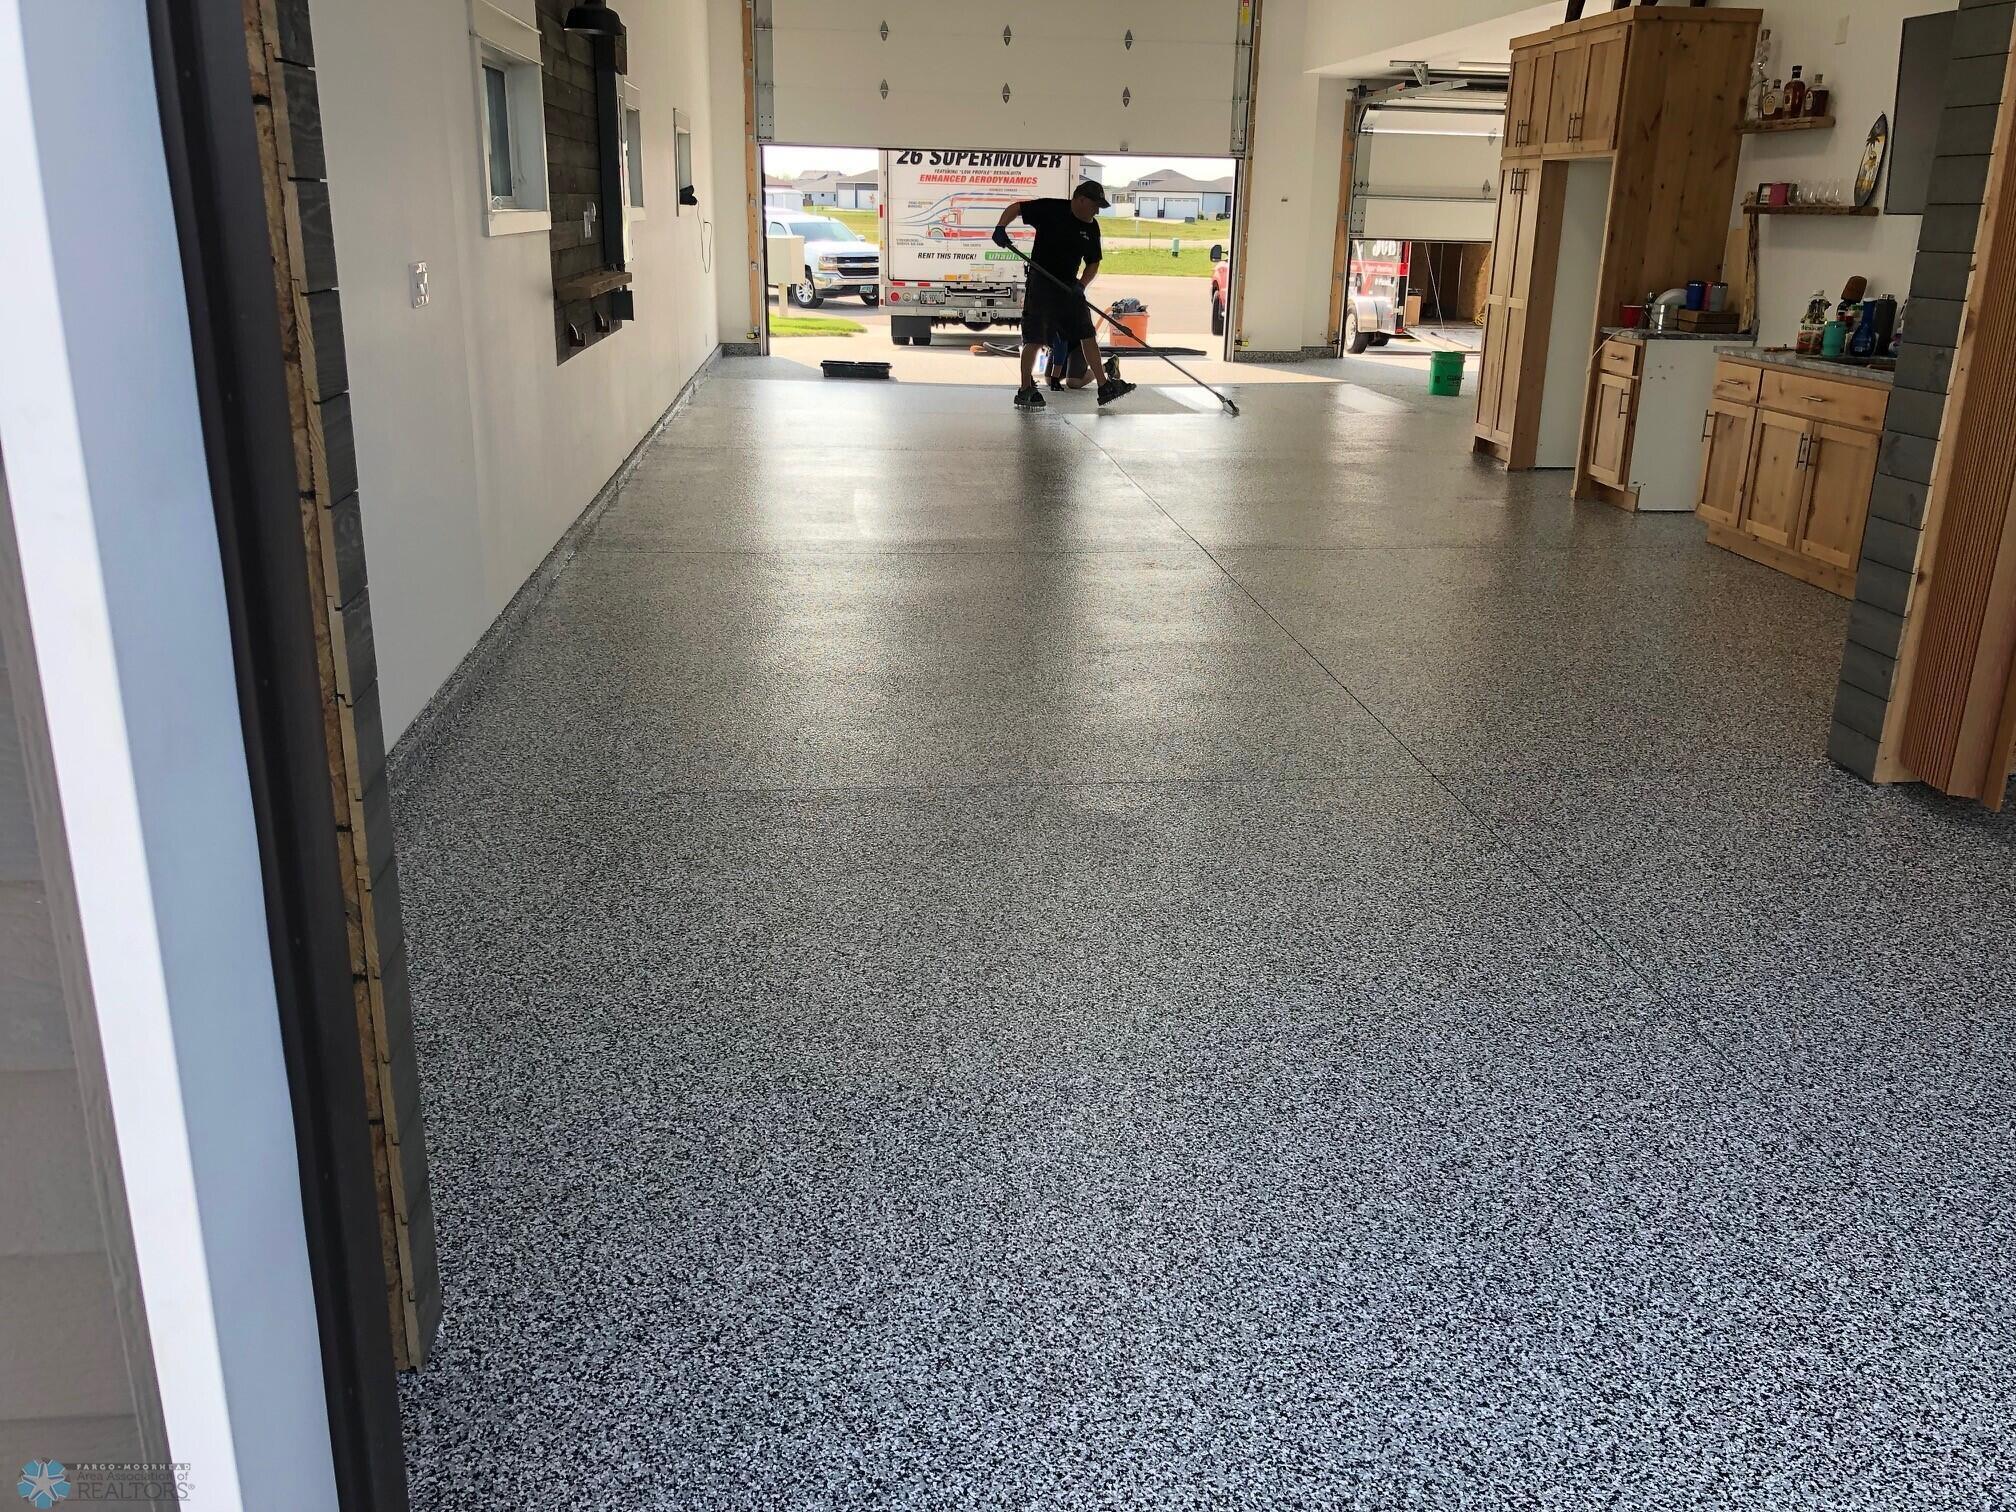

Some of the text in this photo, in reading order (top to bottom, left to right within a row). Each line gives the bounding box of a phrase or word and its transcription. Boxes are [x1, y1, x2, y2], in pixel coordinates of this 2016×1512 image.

[896, 150, 1063, 168] 26 SUPERMOVER
[919, 174, 1038, 185] ENHANCED AERODYNAMICS
[917, 252, 936, 260] RENT
[937, 252, 951, 260] THIS
